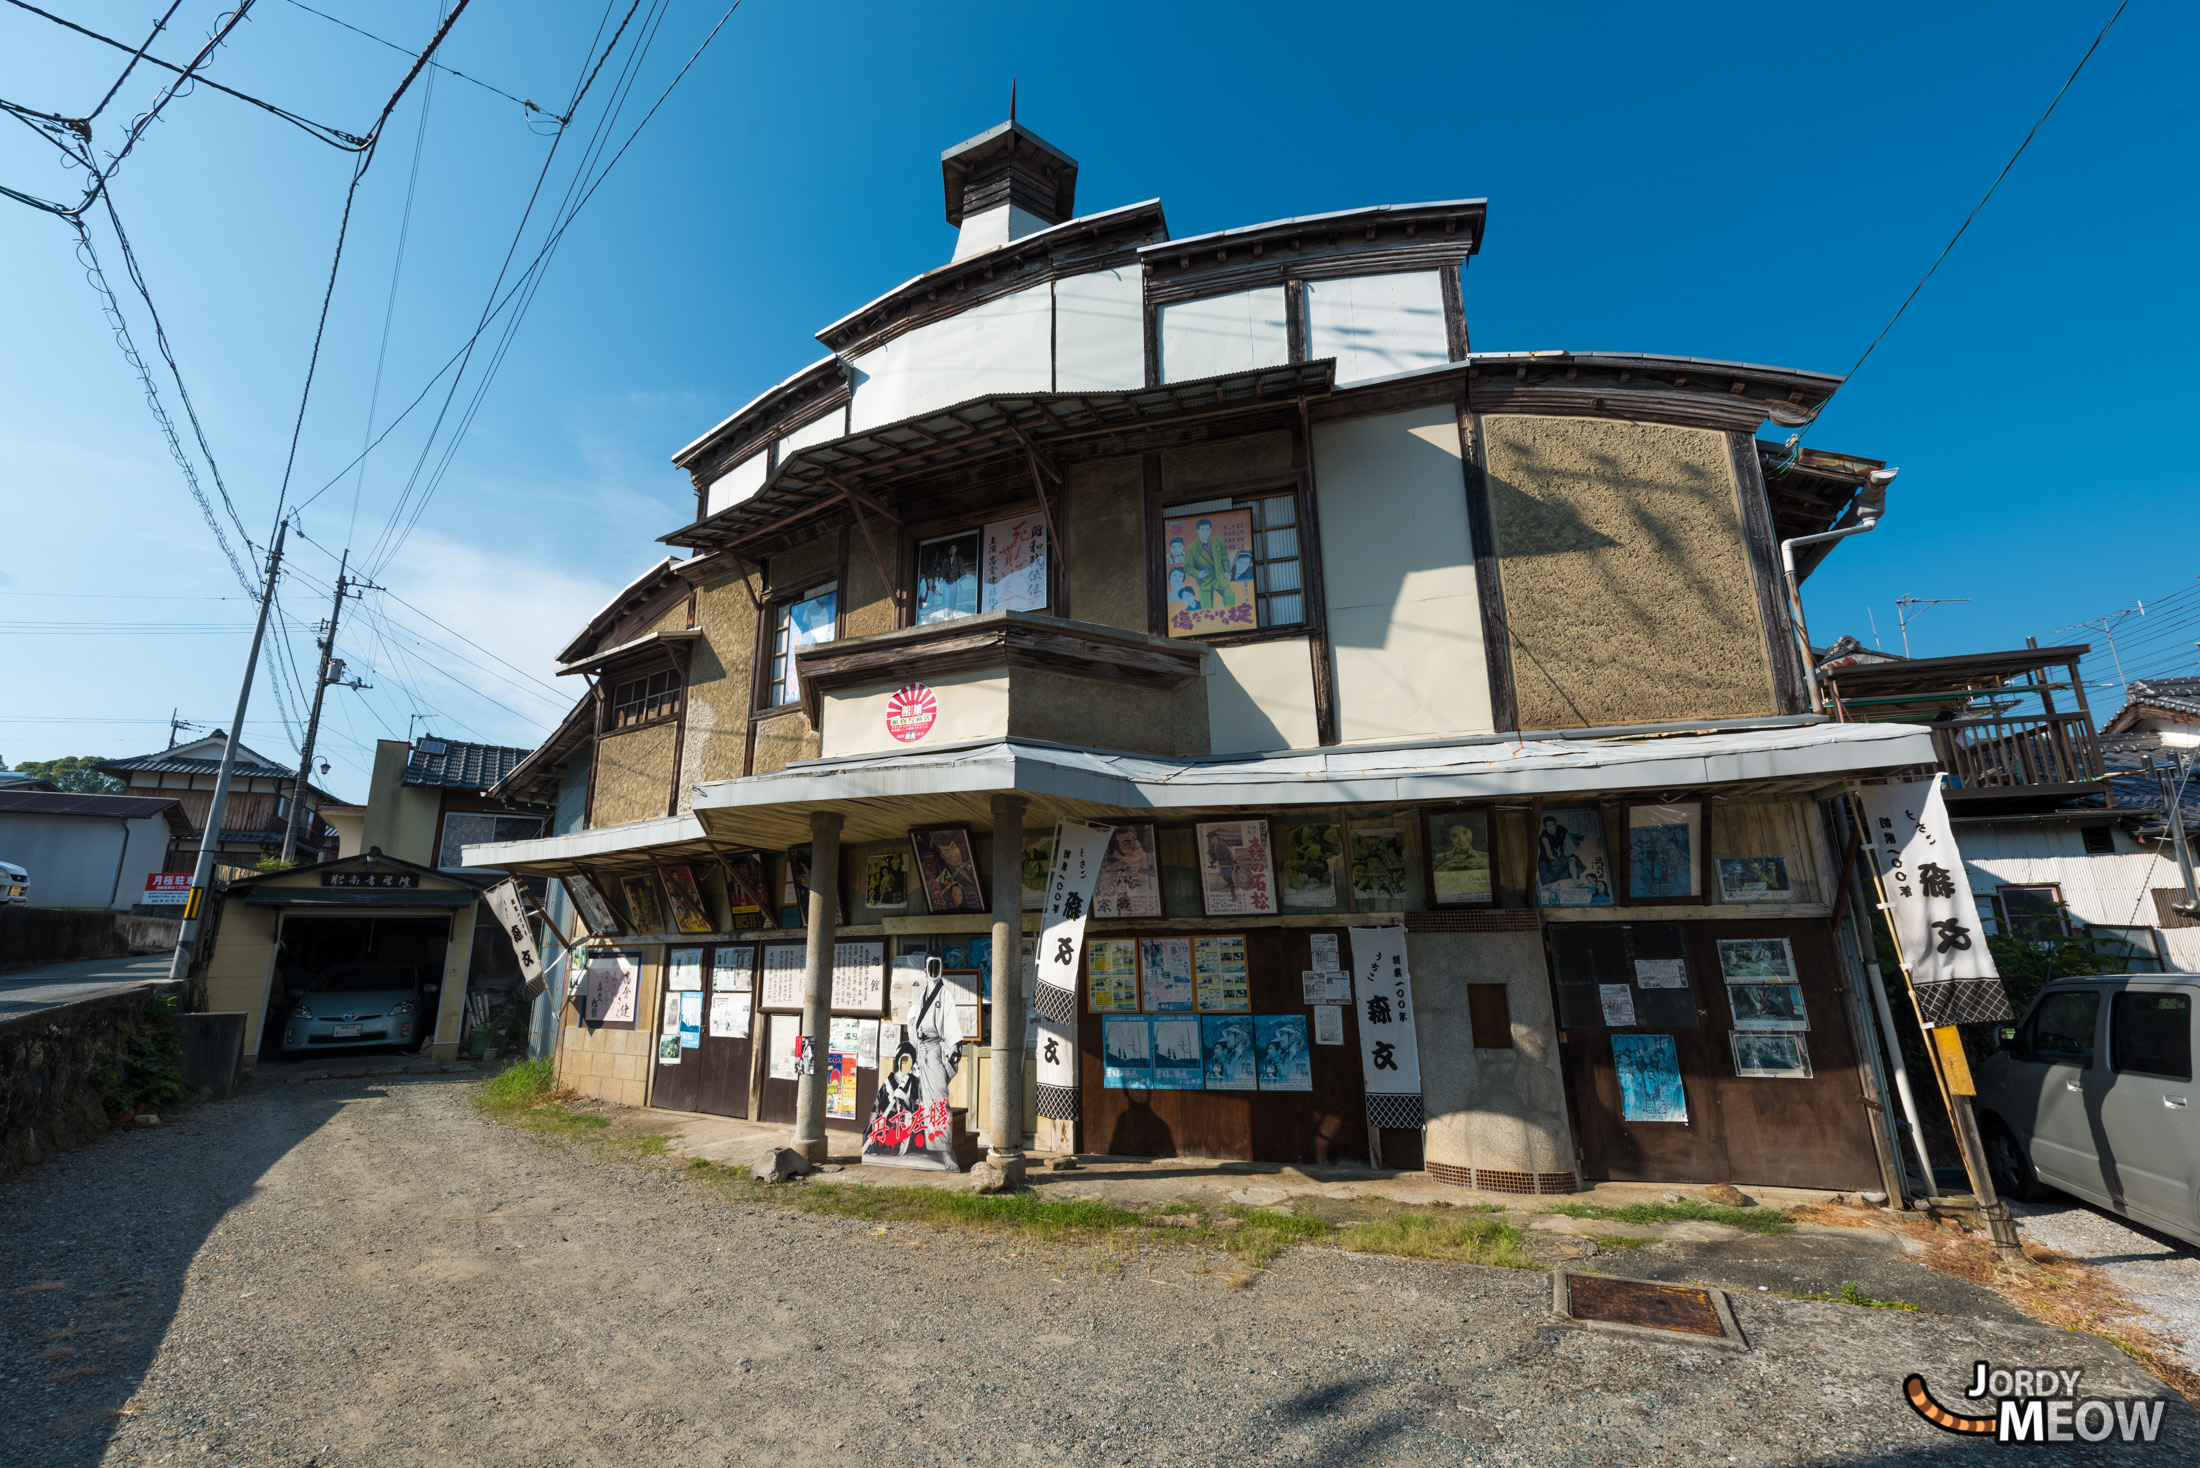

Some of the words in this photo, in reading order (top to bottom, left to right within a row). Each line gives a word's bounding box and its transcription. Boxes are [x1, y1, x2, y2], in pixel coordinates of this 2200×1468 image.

[1171, 603, 1254, 631] 傷だらけの掟
[1248, 836, 1270, 910] 森の石松
[867, 1097, 950, 1144] 丹下左膳
